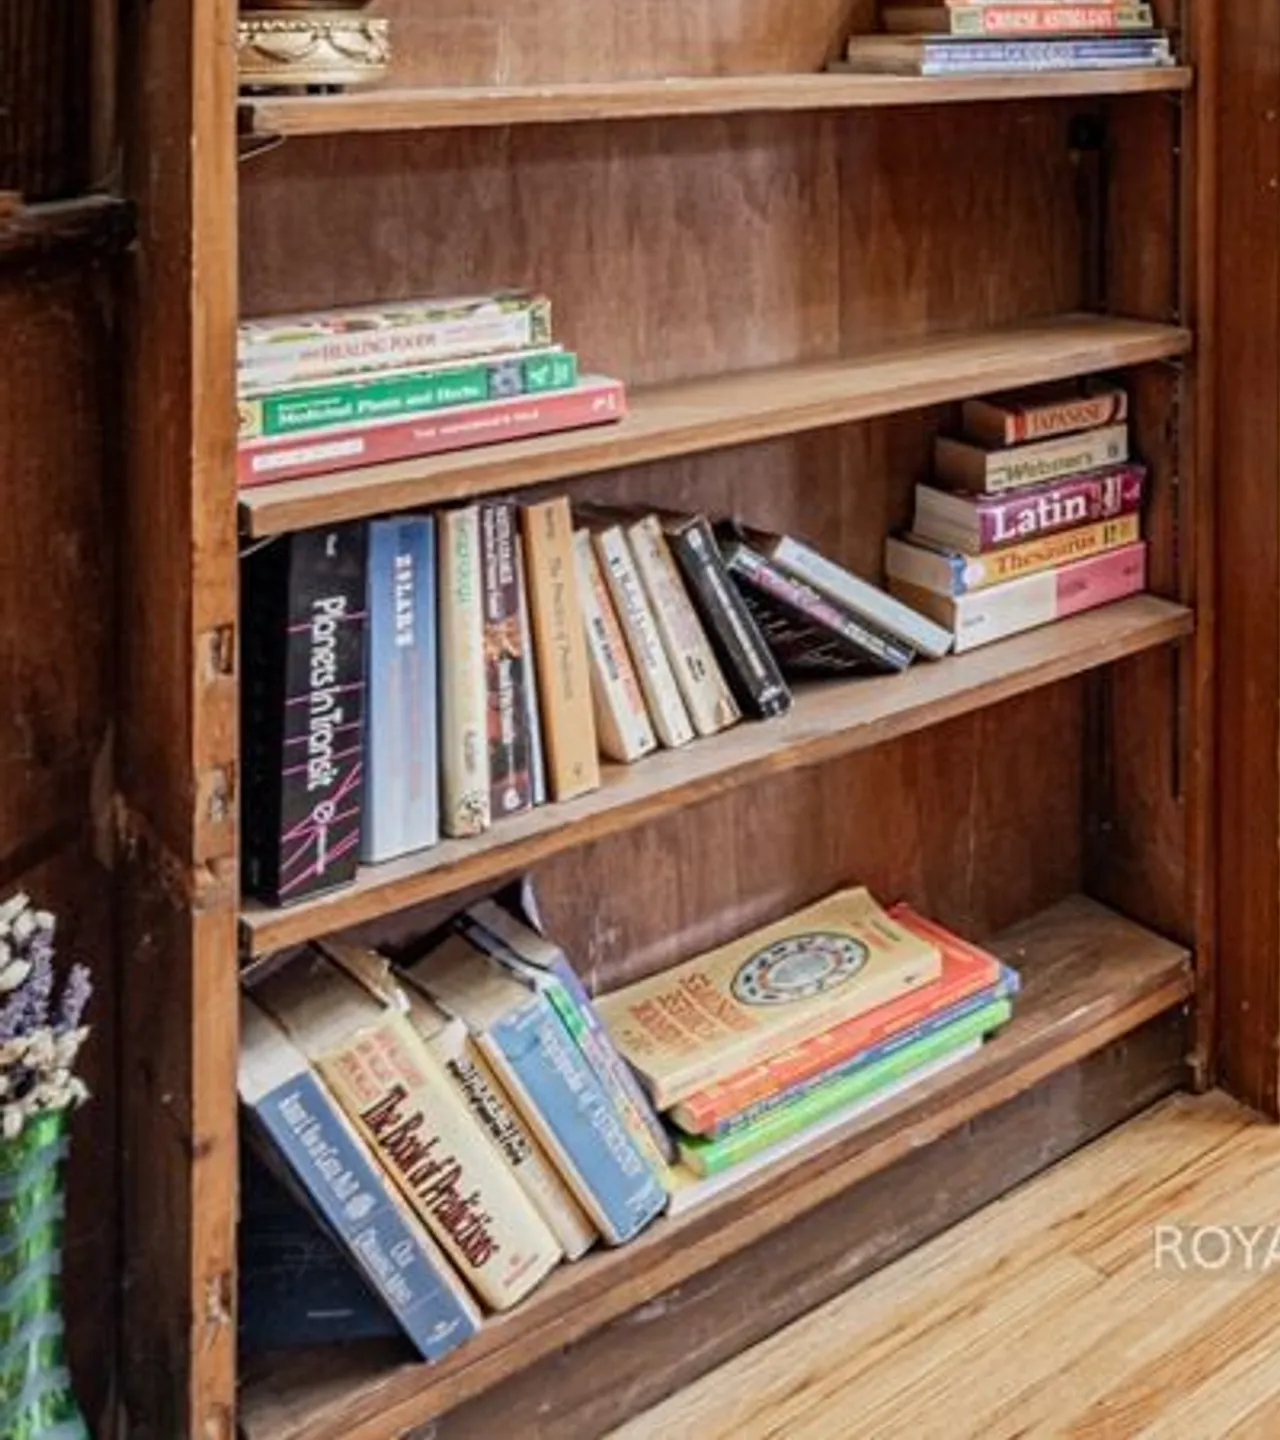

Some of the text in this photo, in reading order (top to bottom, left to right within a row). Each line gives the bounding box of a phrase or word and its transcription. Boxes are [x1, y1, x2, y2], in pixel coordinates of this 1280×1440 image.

[278, 401, 353, 426] Medicinal
[357, 392, 399, 413] Plants
[405, 389, 433, 406] and
[436, 381, 480, 402] Herbs
[991, 491, 1087, 542] Latin
[998, 532, 1096, 573] Thesaurus
[310, 595, 347, 688] Planets
[307, 707, 342, 791] Transit
[359, 1084, 408, 1135] The
[378, 1111, 441, 1175] Book
[406, 1157, 456, 1189] of
[418, 1165, 500, 1269] Predictions
